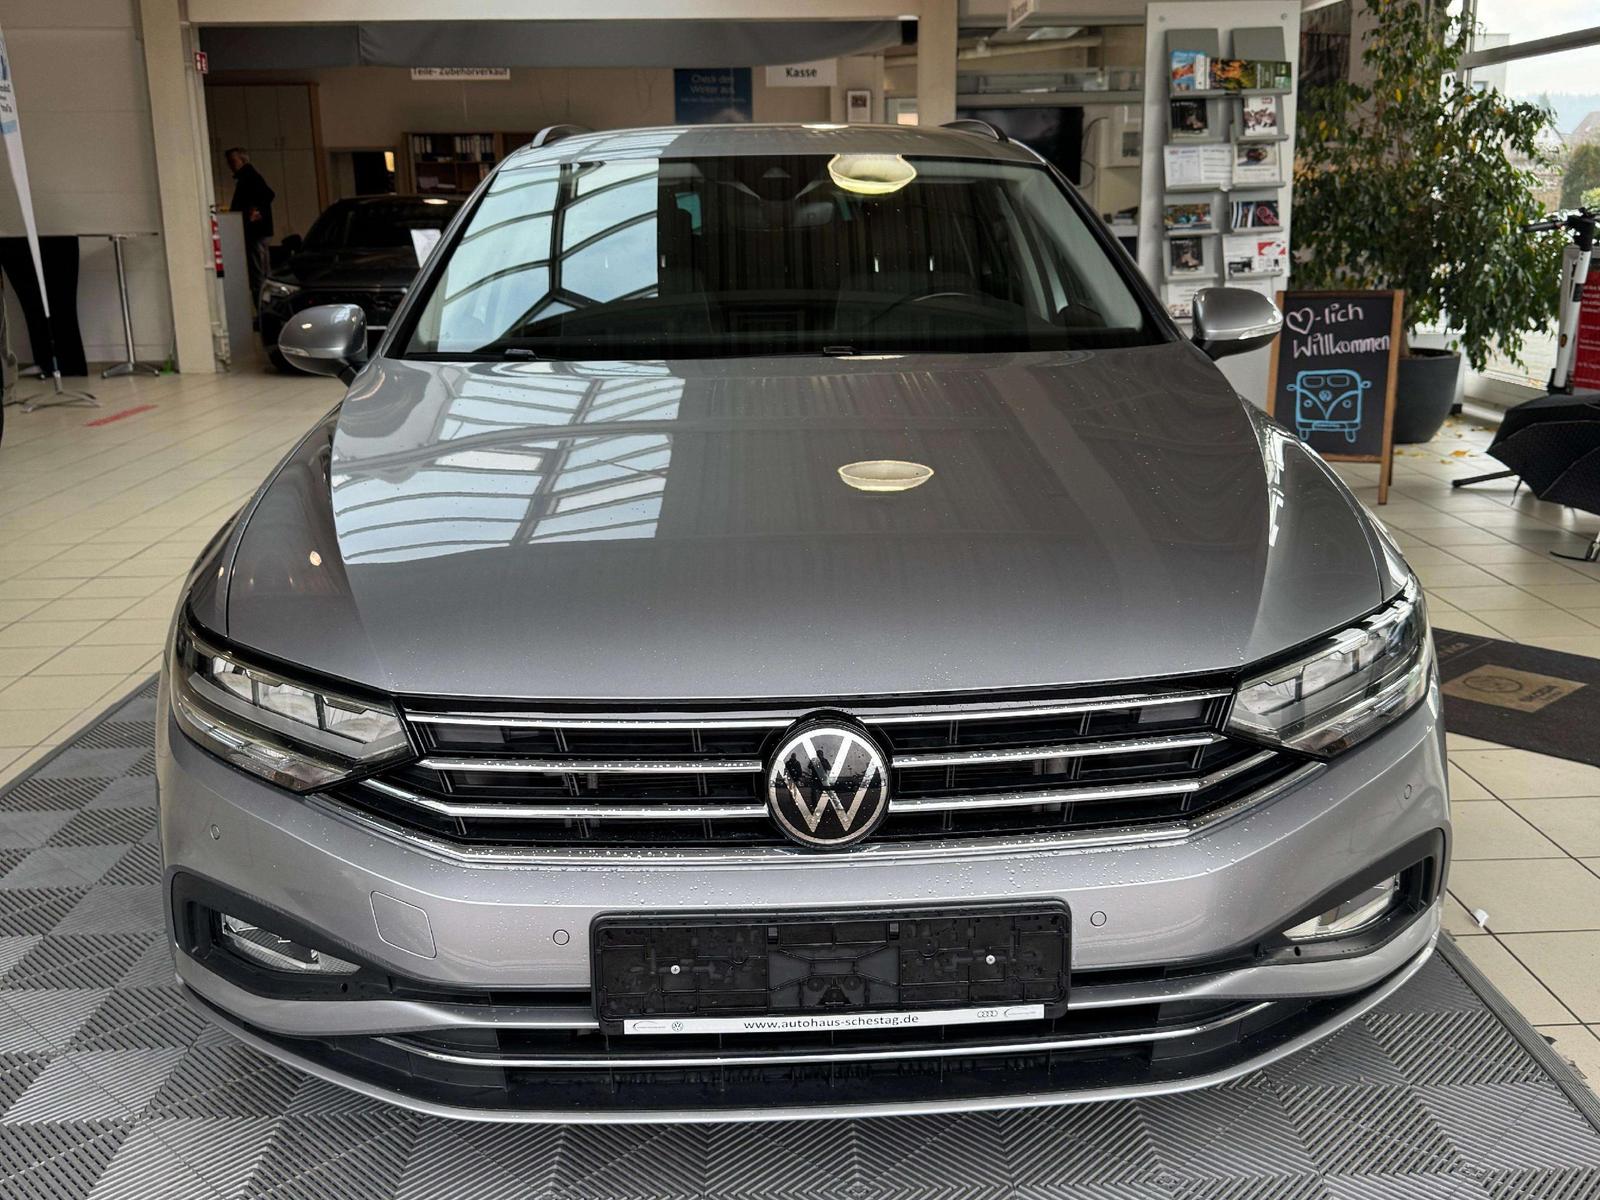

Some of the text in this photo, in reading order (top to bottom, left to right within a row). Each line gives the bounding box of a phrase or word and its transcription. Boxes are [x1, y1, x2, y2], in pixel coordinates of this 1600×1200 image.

[785, 67, 818, 78] Kasse
[1293, 333, 1390, 359] Willkommen
[769, 727, 888, 845] VW
[744, 1014, 919, 1029] www.autohaus-schestag.de
